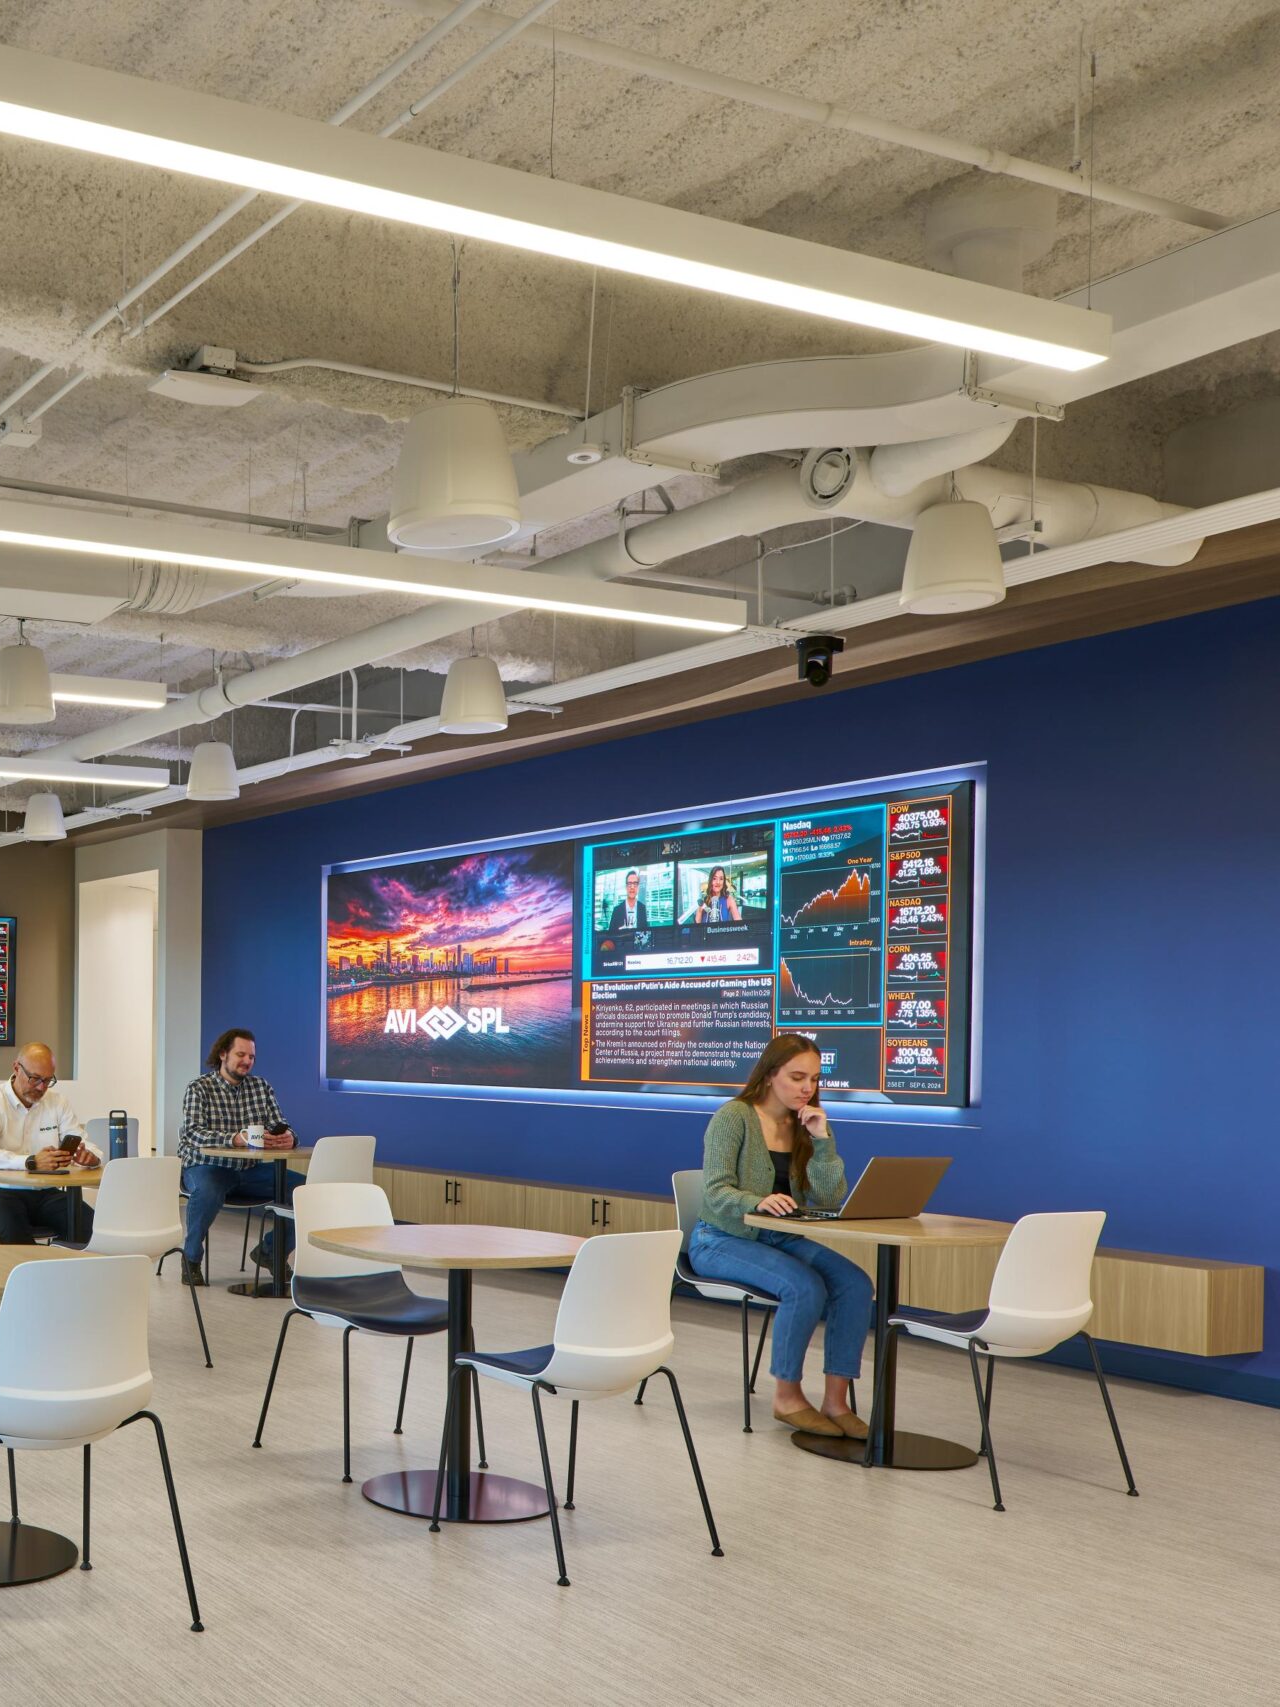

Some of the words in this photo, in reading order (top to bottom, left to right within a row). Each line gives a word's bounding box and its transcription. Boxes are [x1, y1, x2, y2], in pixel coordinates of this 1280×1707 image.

[891, 805, 909, 814] DOW
[898, 809, 940, 822] 40375.00
[783, 821, 811, 831] Nasdaq
[892, 821, 920, 831] -380.75
[922, 817, 946, 828] 0.93%
[906, 851, 921, 859] 500
[902, 858, 934, 869] 5412.16
[896, 868, 917, 877] -91.25
[920, 866, 941, 875] 1.66%
[889, 898, 921, 907] NASDAQ
[899, 905, 936, 916] 16712.20
[892, 915, 919, 924] -415.46
[920, 913, 944, 923] 2.43%
[706, 925, 749, 934] Businessweek
[888, 945, 911, 953] CORN
[901, 953, 932, 962] 406.25
[896, 962, 915, 970] -4.50
[917, 961, 938, 970] 1.10%
[641, 982, 664, 990] Putin's
[680, 980, 710, 988] Accused
[711, 980, 718, 988] of
[720, 979, 747, 988] Gaming
[748, 978, 760, 986] the
[761, 978, 772, 986] US
[888, 992, 915, 1000] WHEAT
[596, 1005, 624, 1013] Kiriyenko,
[636, 1003, 672, 1012] participated
[681, 1002, 711, 1011] meetings
[741, 1001, 769, 1010] Russian
[900, 1001, 931, 1009] 567.00
[666, 1012, 690, 1020] promote
[691, 1011, 712, 1019] Donald
[713, 1011, 737, 1019] Trump's
[738, 1010, 772, 1020] candidacy,
[895, 1010, 913, 1018] -7.75
[383, 1008, 417, 1034] AVI
[466, 1007, 510, 1033] SPL
[625, 1021, 646, 1029] support
[657, 1020, 679, 1028] Ukraine
[680, 1020, 691, 1028] and
[693, 1020, 714, 1028] further
[715, 1020, 740, 1028] Russian
[741, 1020, 771, 1028] interests,
[595, 1029, 624, 1037] according
[661, 1029, 681, 1037] filings.
[607, 1040, 626, 1048] Kremlin
[668, 1041, 686, 1049] Friday
[744, 1041, 769, 1049] Nation
[620, 1049, 639, 1057] Russia,
[645, 1049, 665, 1057] project
[692, 1050, 729, 1058] demonstrate
[742, 1051, 762, 1059] countr
[897, 1048, 932, 1057] 1004.50
[595, 1057, 634, 1065] achievements
[636, 1057, 647, 1065] and
[648, 1058, 681, 1066] strengthen
[683, 1058, 709, 1066] national
[710, 1059, 737, 1068] identity.
[821, 1053, 836, 1064] EET
[827, 1080, 840, 1088] 6AM
